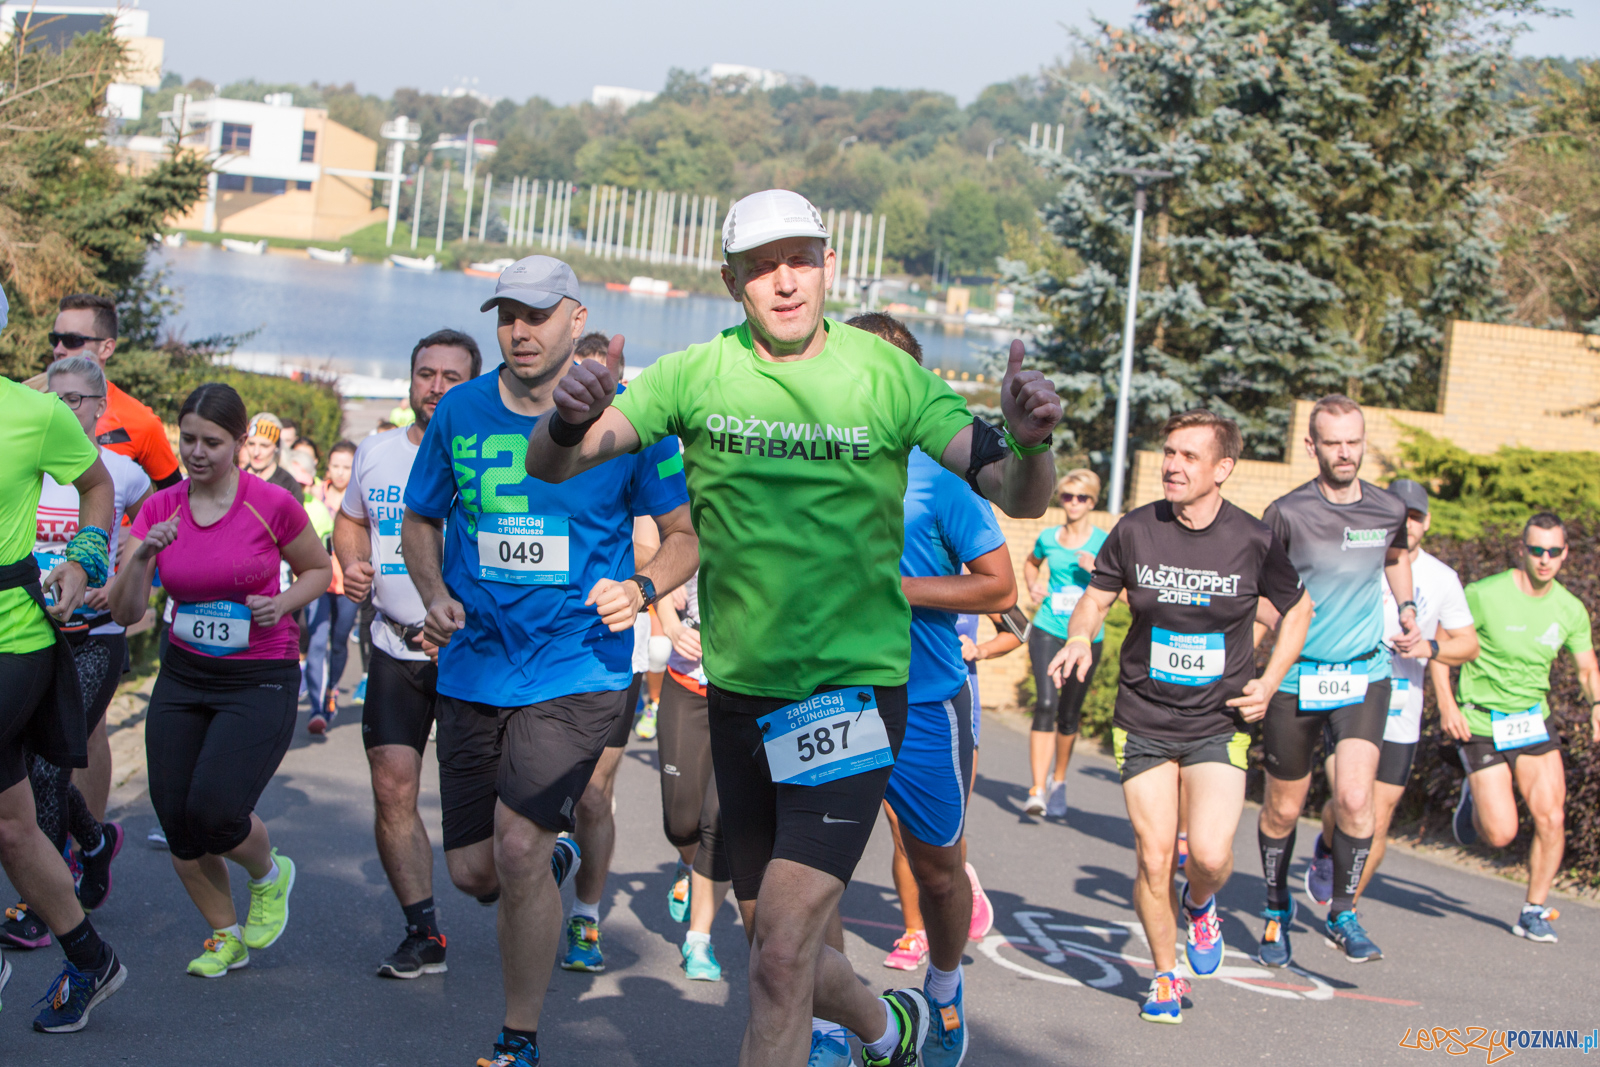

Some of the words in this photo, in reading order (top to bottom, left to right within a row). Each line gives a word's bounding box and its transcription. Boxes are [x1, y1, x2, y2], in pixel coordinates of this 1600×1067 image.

[706, 413, 869, 444] ODŻYWIANIE
[708, 431, 870, 461] HERBALIFE
[498, 516, 544, 528] zaBIEGaj
[504, 527, 544, 535] FUNdusze
[499, 540, 544, 564] 049
[1135, 563, 1241, 594] VASALOPPET
[1157, 589, 1192, 605] 2013
[193, 620, 230, 641] 613
[1169, 634, 1207, 645] zaBIEGaj
[1169, 652, 1205, 670] 064
[1318, 680, 1350, 695] 604
[786, 692, 844, 720] zaBIEGaj
[797, 706, 846, 726] FUNdusze
[1506, 721, 1530, 736] 212
[797, 719, 850, 762] 587
